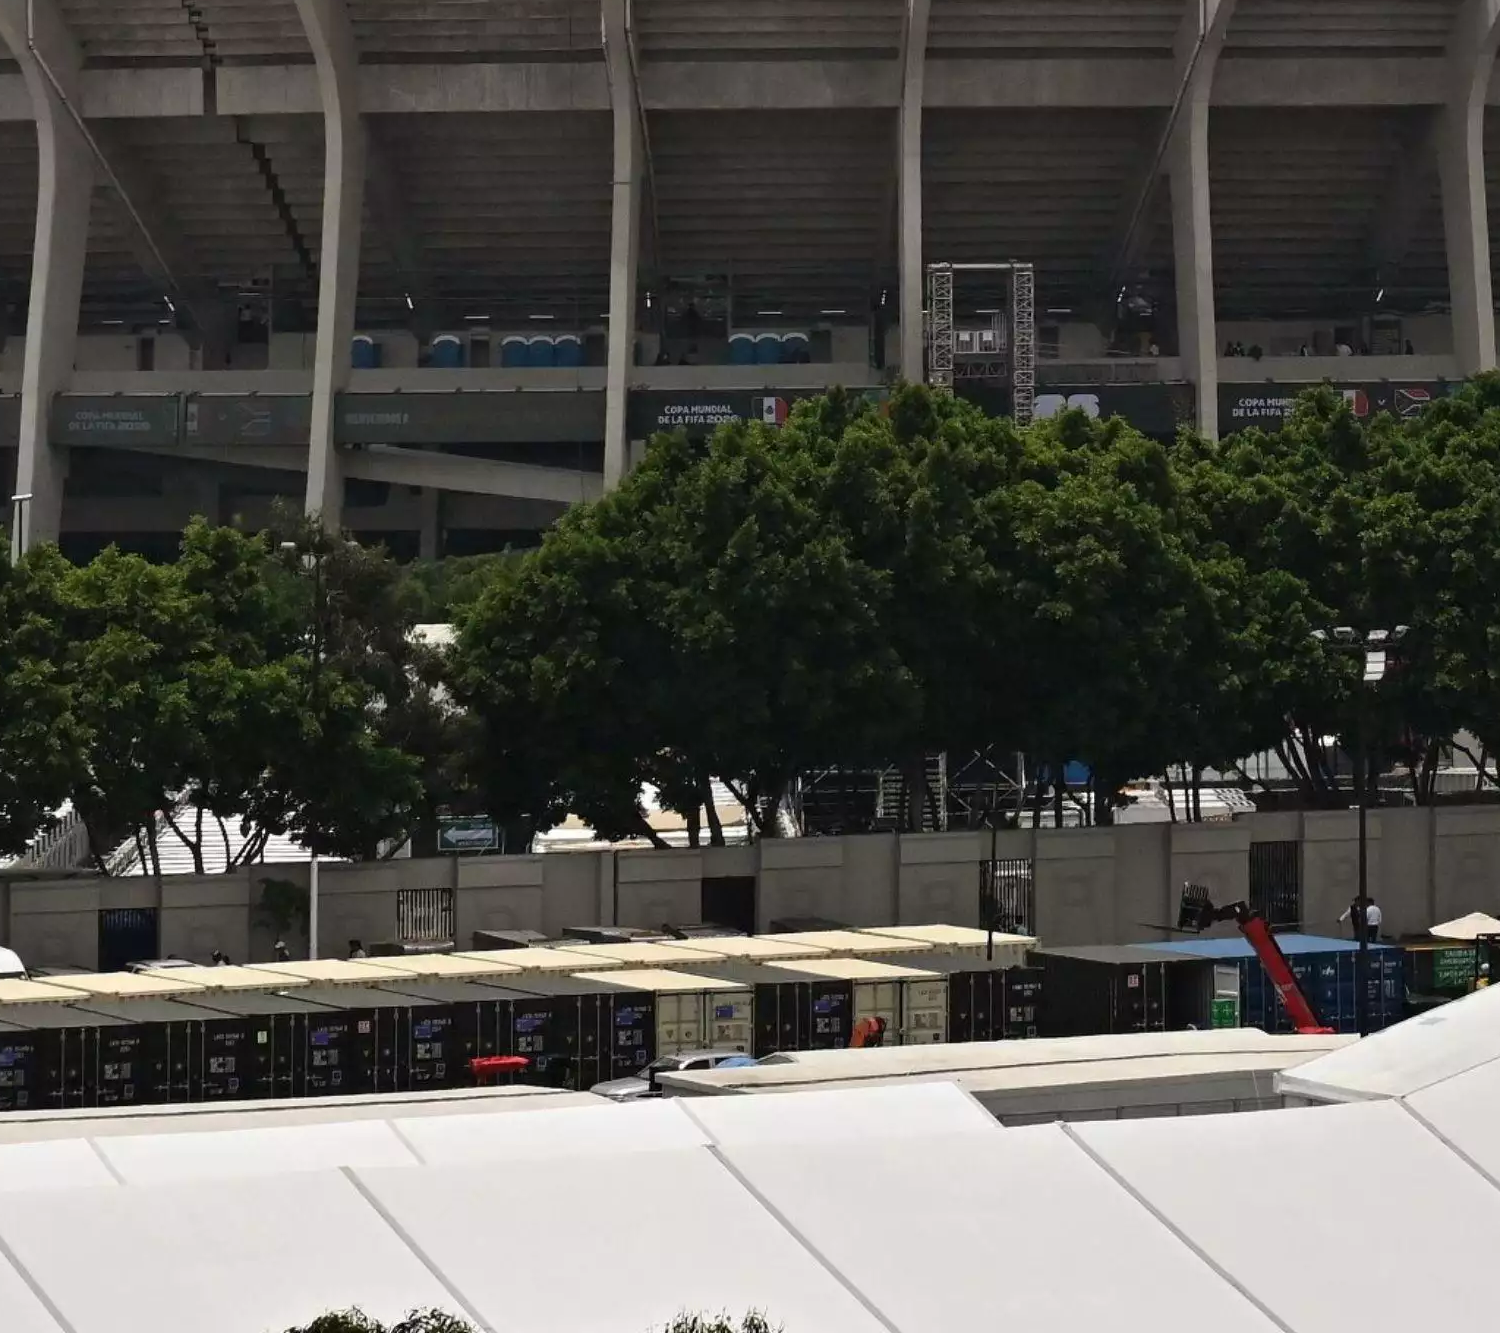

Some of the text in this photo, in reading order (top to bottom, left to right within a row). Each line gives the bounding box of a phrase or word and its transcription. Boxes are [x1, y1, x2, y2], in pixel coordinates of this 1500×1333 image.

[1238, 398, 1265, 407] COPA
[664, 405, 733, 414] COPA MUNDIAL
[1261, 408, 1281, 417] FIFA
[657, 415, 669, 424] DE
[671, 415, 683, 424] LA
[685, 415, 704, 424] FIFA
